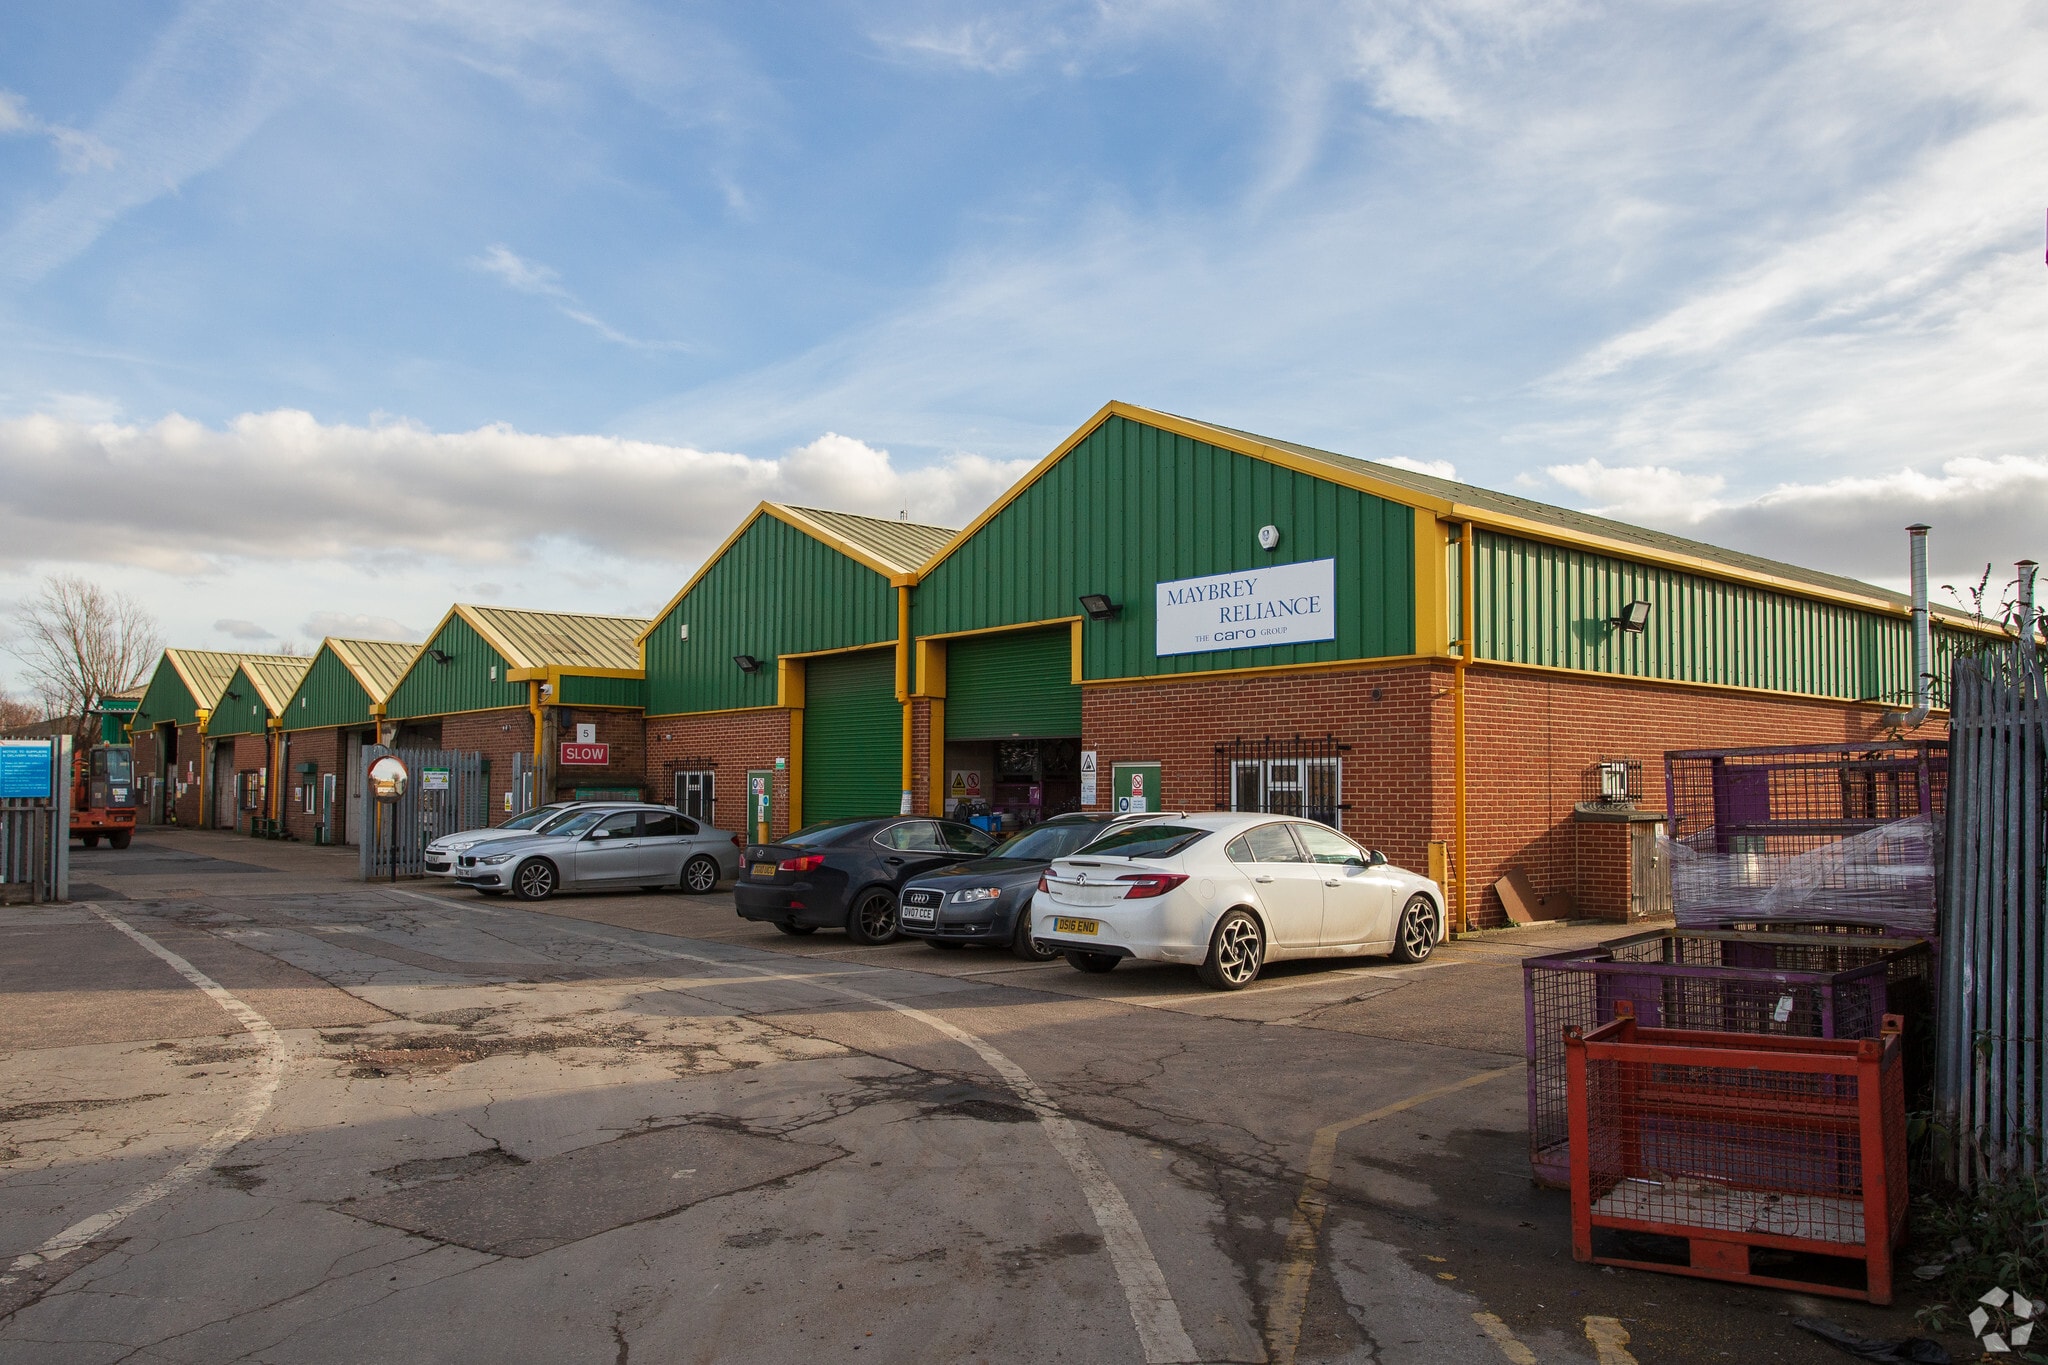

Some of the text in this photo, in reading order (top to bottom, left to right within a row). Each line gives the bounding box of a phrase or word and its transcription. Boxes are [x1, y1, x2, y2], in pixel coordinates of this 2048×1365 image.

[1167, 578, 1258, 606] MAYBREY
[1219, 595, 1322, 624] RELIANCE
[1195, 626, 1288, 643] THE caro GROUP
[583, 729, 590, 738] 5
[566, 747, 605, 760] SLOW
[919, 909, 932, 919] CCE
[1059, 921, 1096, 933] DS16 END
